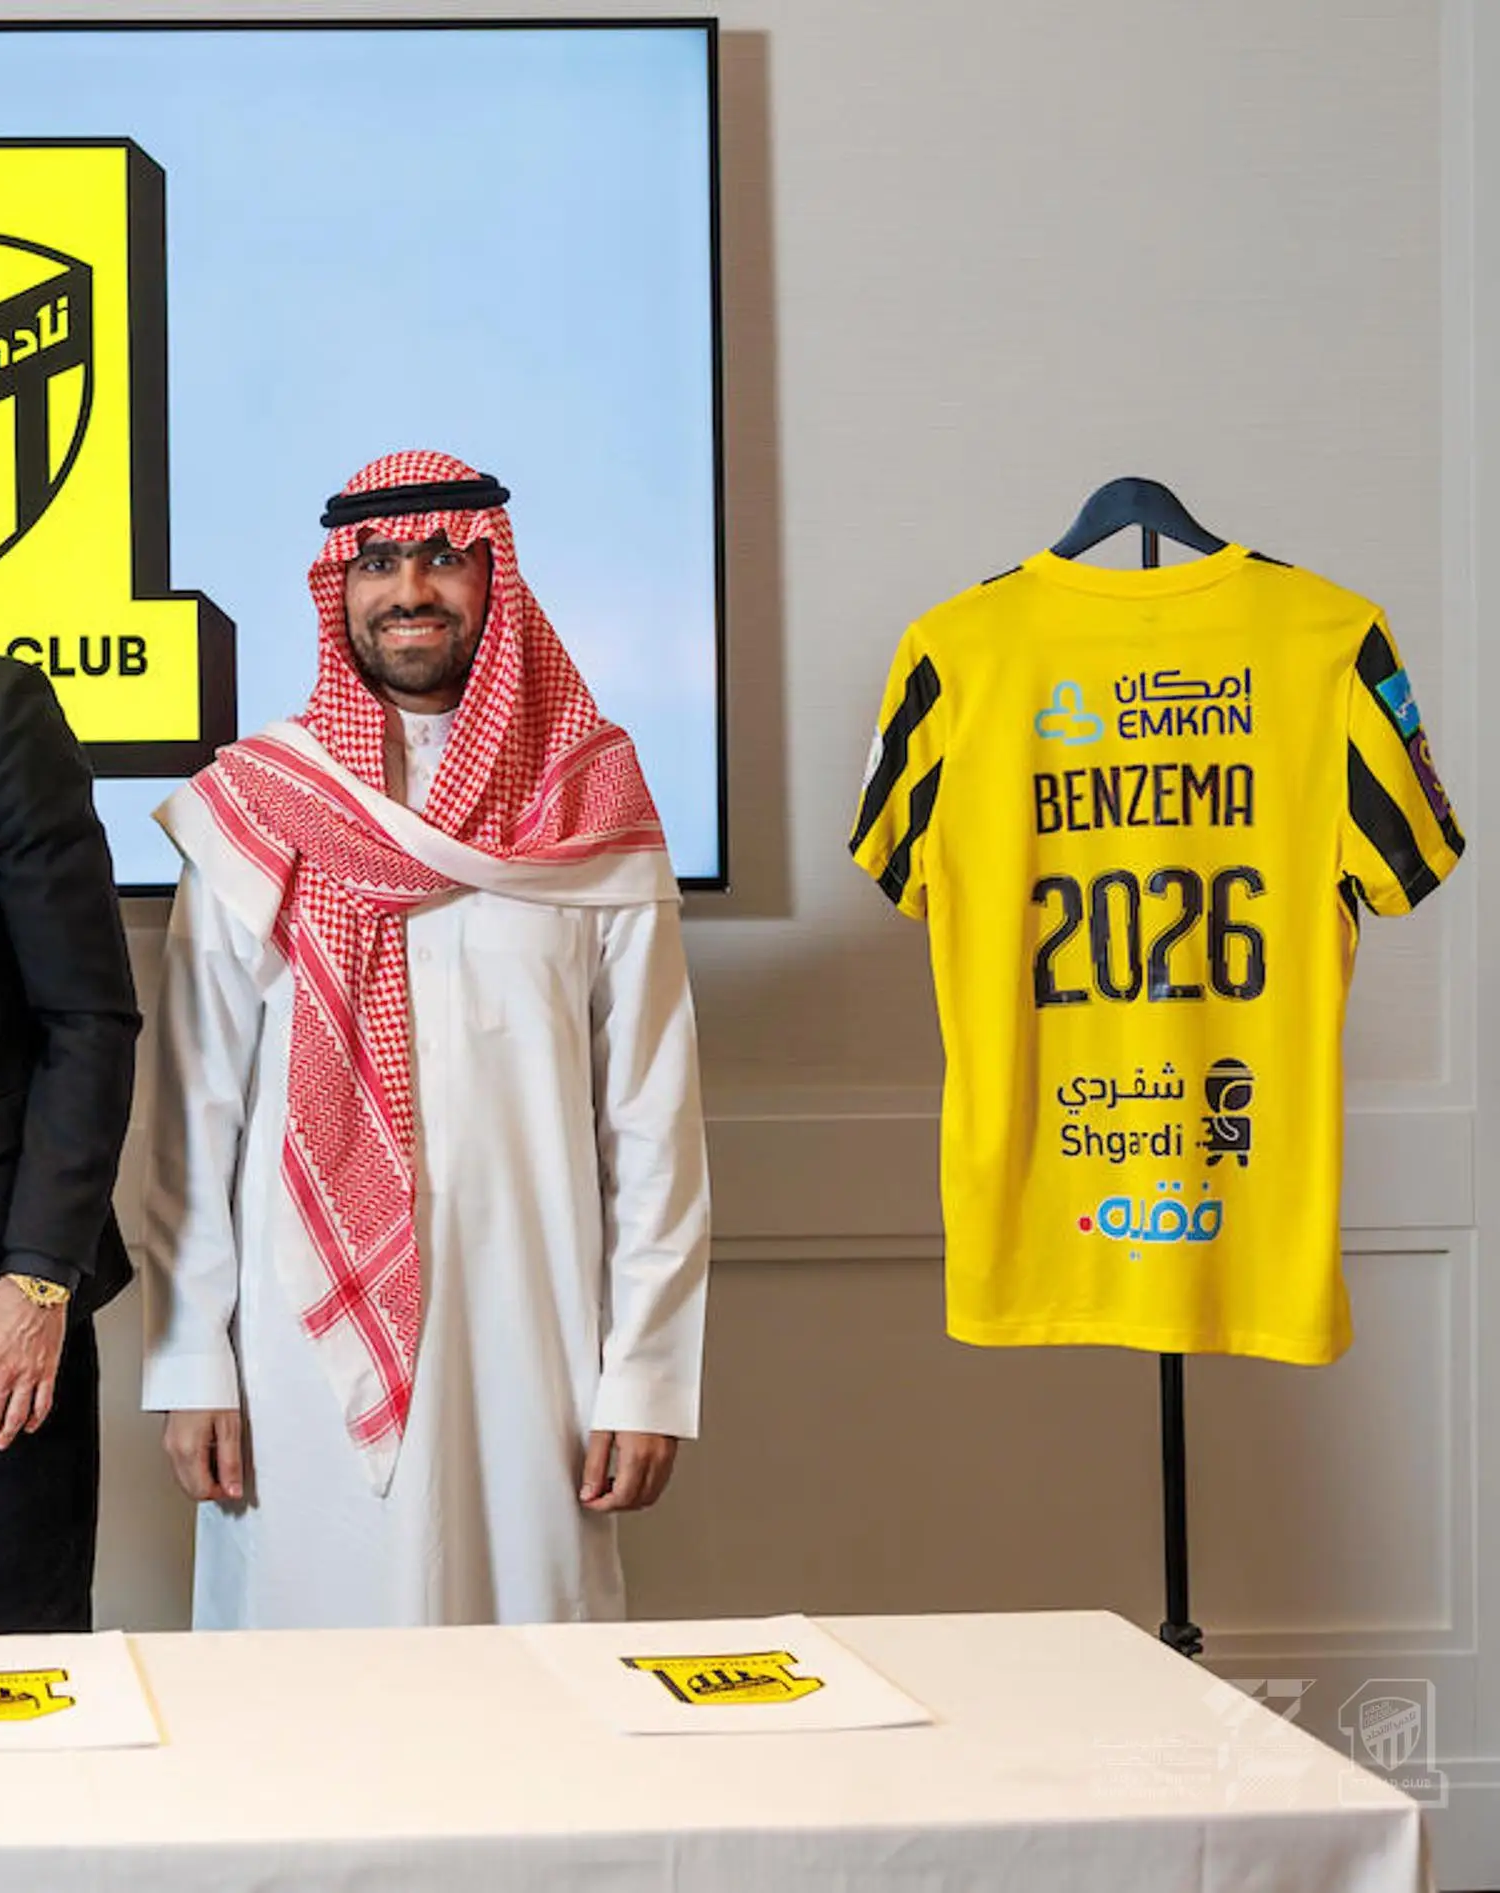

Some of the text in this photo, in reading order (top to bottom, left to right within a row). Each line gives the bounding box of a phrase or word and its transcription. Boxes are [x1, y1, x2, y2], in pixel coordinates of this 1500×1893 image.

[6, 635, 148, 677] CLUB
[1118, 704, 1252, 739] EMKAN
[1033, 762, 1255, 836] BENZEMA
[1031, 865, 1266, 1008] 2026
